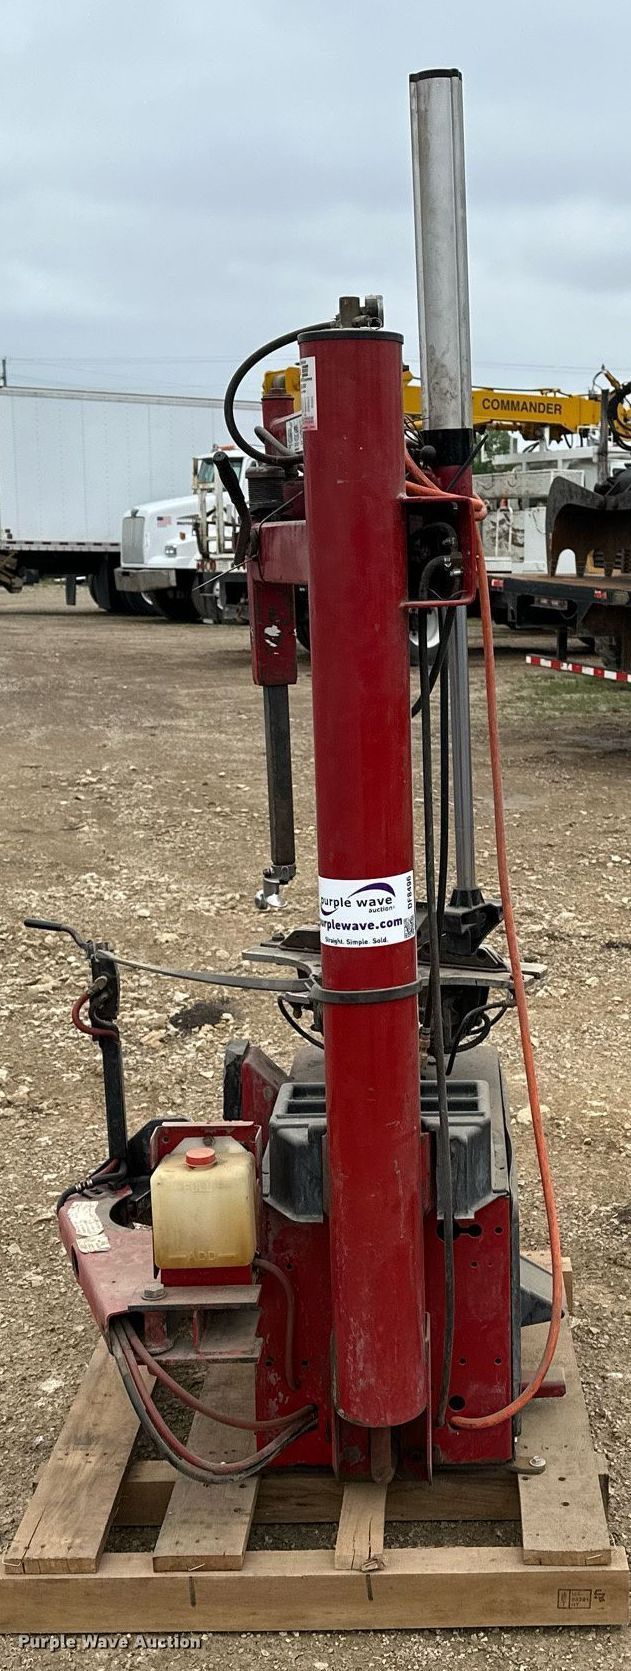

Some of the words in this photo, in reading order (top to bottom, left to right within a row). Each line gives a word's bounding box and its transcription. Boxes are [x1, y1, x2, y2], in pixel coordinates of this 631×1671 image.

[481, 398, 563, 415] COMMANDER
[320, 896, 352, 909] purple
[356, 896, 393, 908] wave
